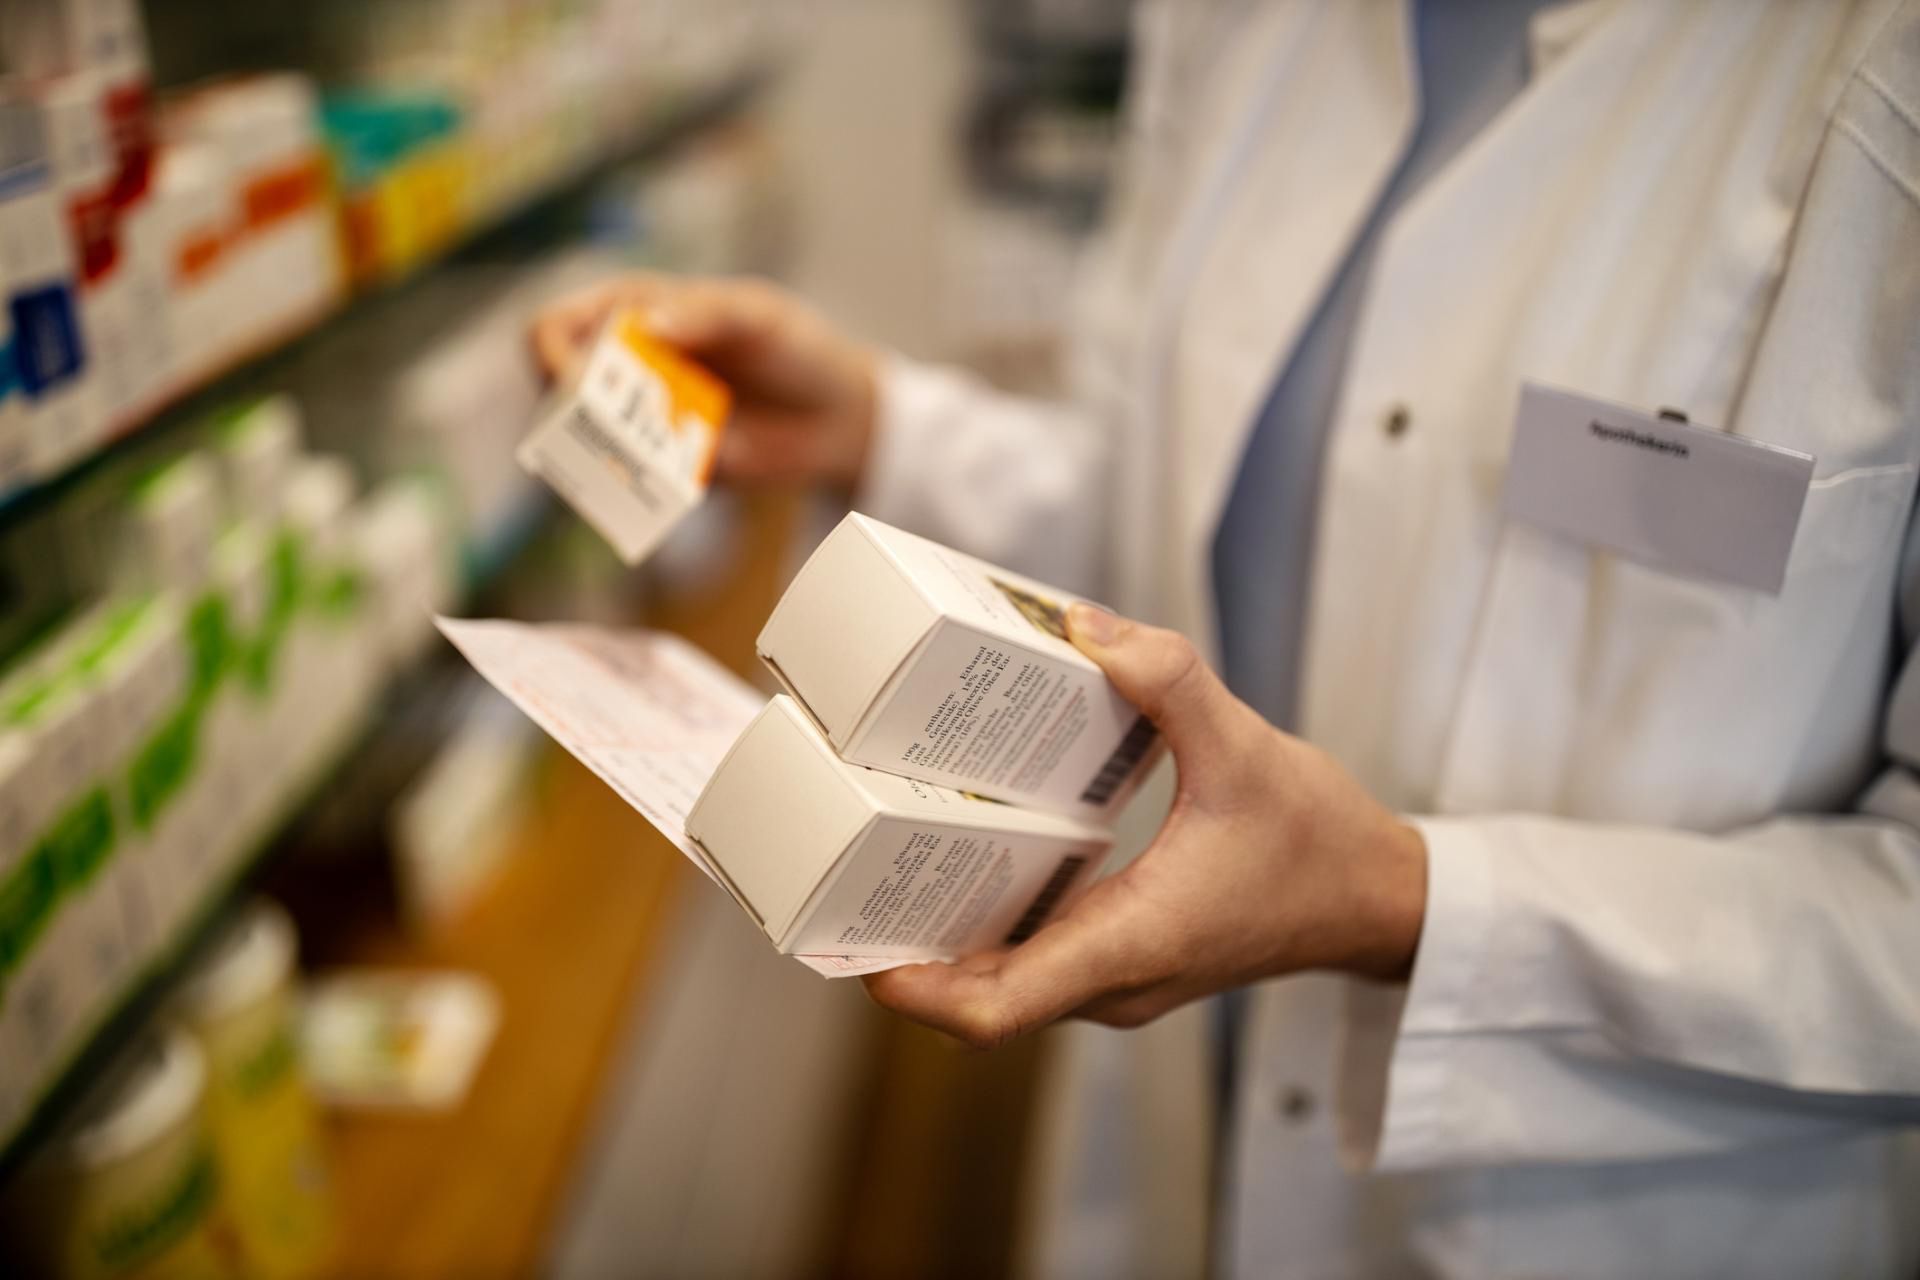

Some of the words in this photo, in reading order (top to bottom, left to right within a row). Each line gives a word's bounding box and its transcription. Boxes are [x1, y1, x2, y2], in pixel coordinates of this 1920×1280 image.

[991, 652, 1002, 666] der
[1021, 665, 1039, 686] Olive
[901, 742, 920, 760] 100g
[924, 690, 956, 732] enthalten:
[959, 646, 986, 679] Ethanol
[955, 718, 966, 732] der
[964, 695, 983, 717] Olive
[981, 672, 1000, 694] (Olea
[996, 655, 1010, 670] Eu-
[910, 747, 926, 763] (aus
[928, 700, 959, 738] Getreide)
[961, 674, 978, 691] 18%
[892, 832, 919, 864] Ethanol
[923, 834, 934, 847] der
[888, 897, 899, 909] der
[897, 874, 915, 895] Olive
